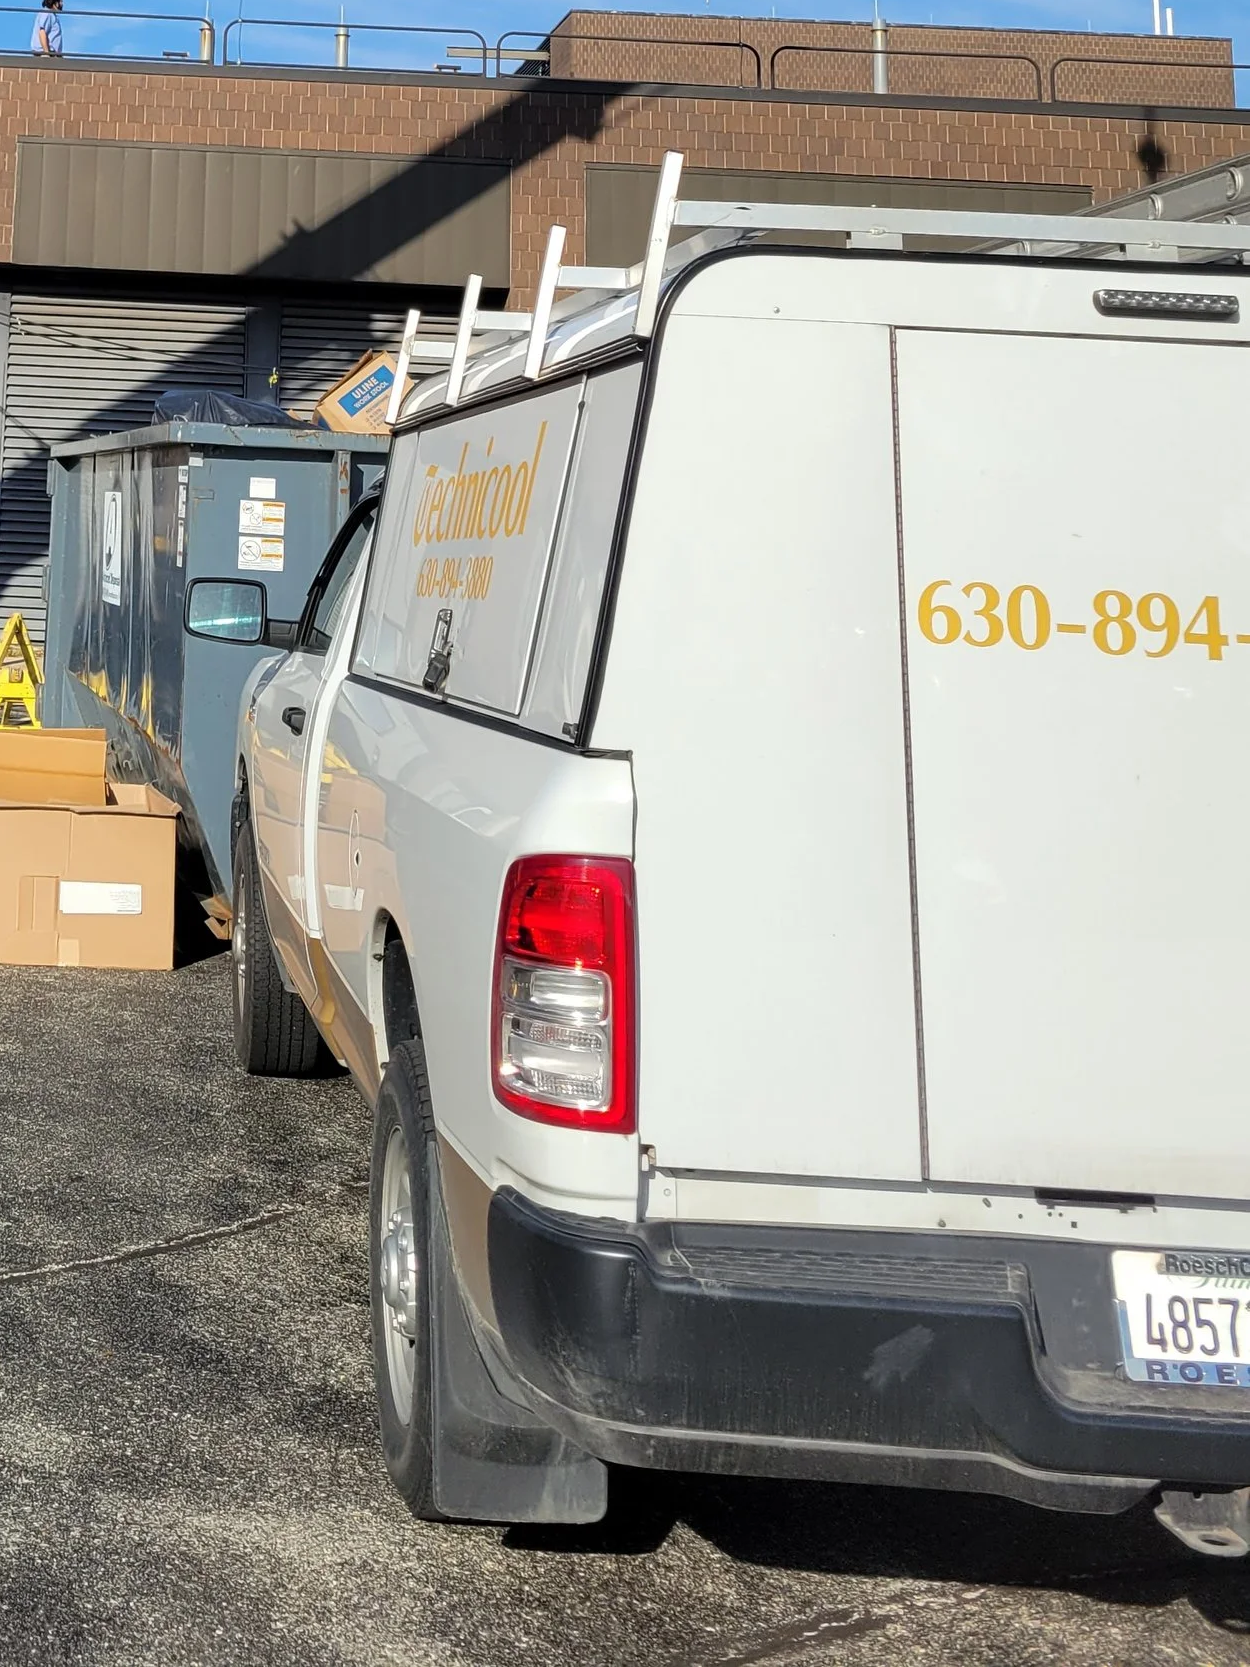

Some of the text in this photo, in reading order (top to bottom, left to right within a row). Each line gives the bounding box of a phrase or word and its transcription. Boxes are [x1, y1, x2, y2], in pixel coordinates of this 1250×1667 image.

[351, 376, 379, 399] ULINE
[353, 391, 373, 409] WORK
[370, 381, 390, 399] STOOL
[413, 421, 548, 546] Technicool
[416, 556, 494, 601] 630-894-3880
[1145, 1293, 1240, 1358] 4857
[1145, 1360, 1250, 1386] ROE
